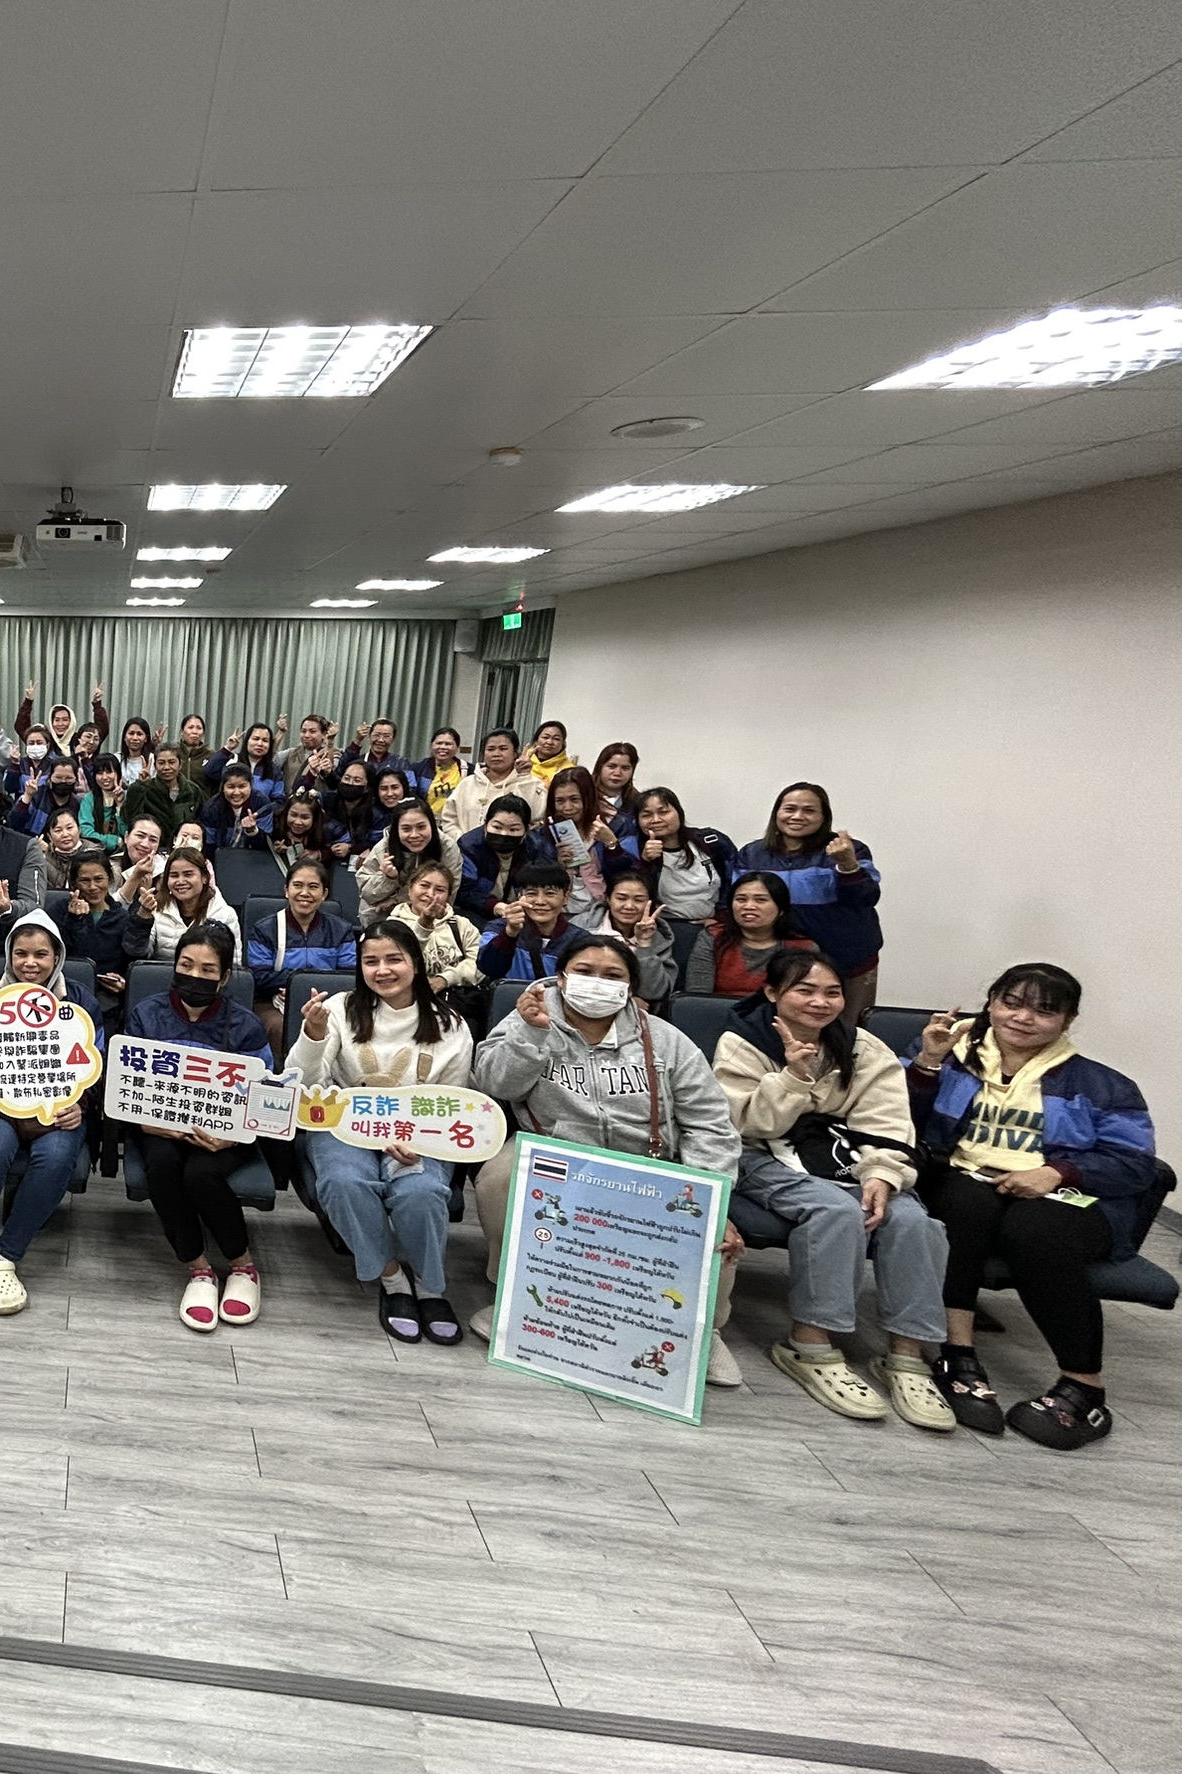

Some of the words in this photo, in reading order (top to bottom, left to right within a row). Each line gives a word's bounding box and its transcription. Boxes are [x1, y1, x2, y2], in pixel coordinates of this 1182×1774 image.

[120, 1045, 247, 1087] 投資三不
[352, 1095, 400, 1117] 反詐
[351, 1120, 475, 1149] 叫我第一名
[571, 1171, 663, 1200] รถจักรยานไฟฟ้า
[537, 1230, 550, 1240] 25
